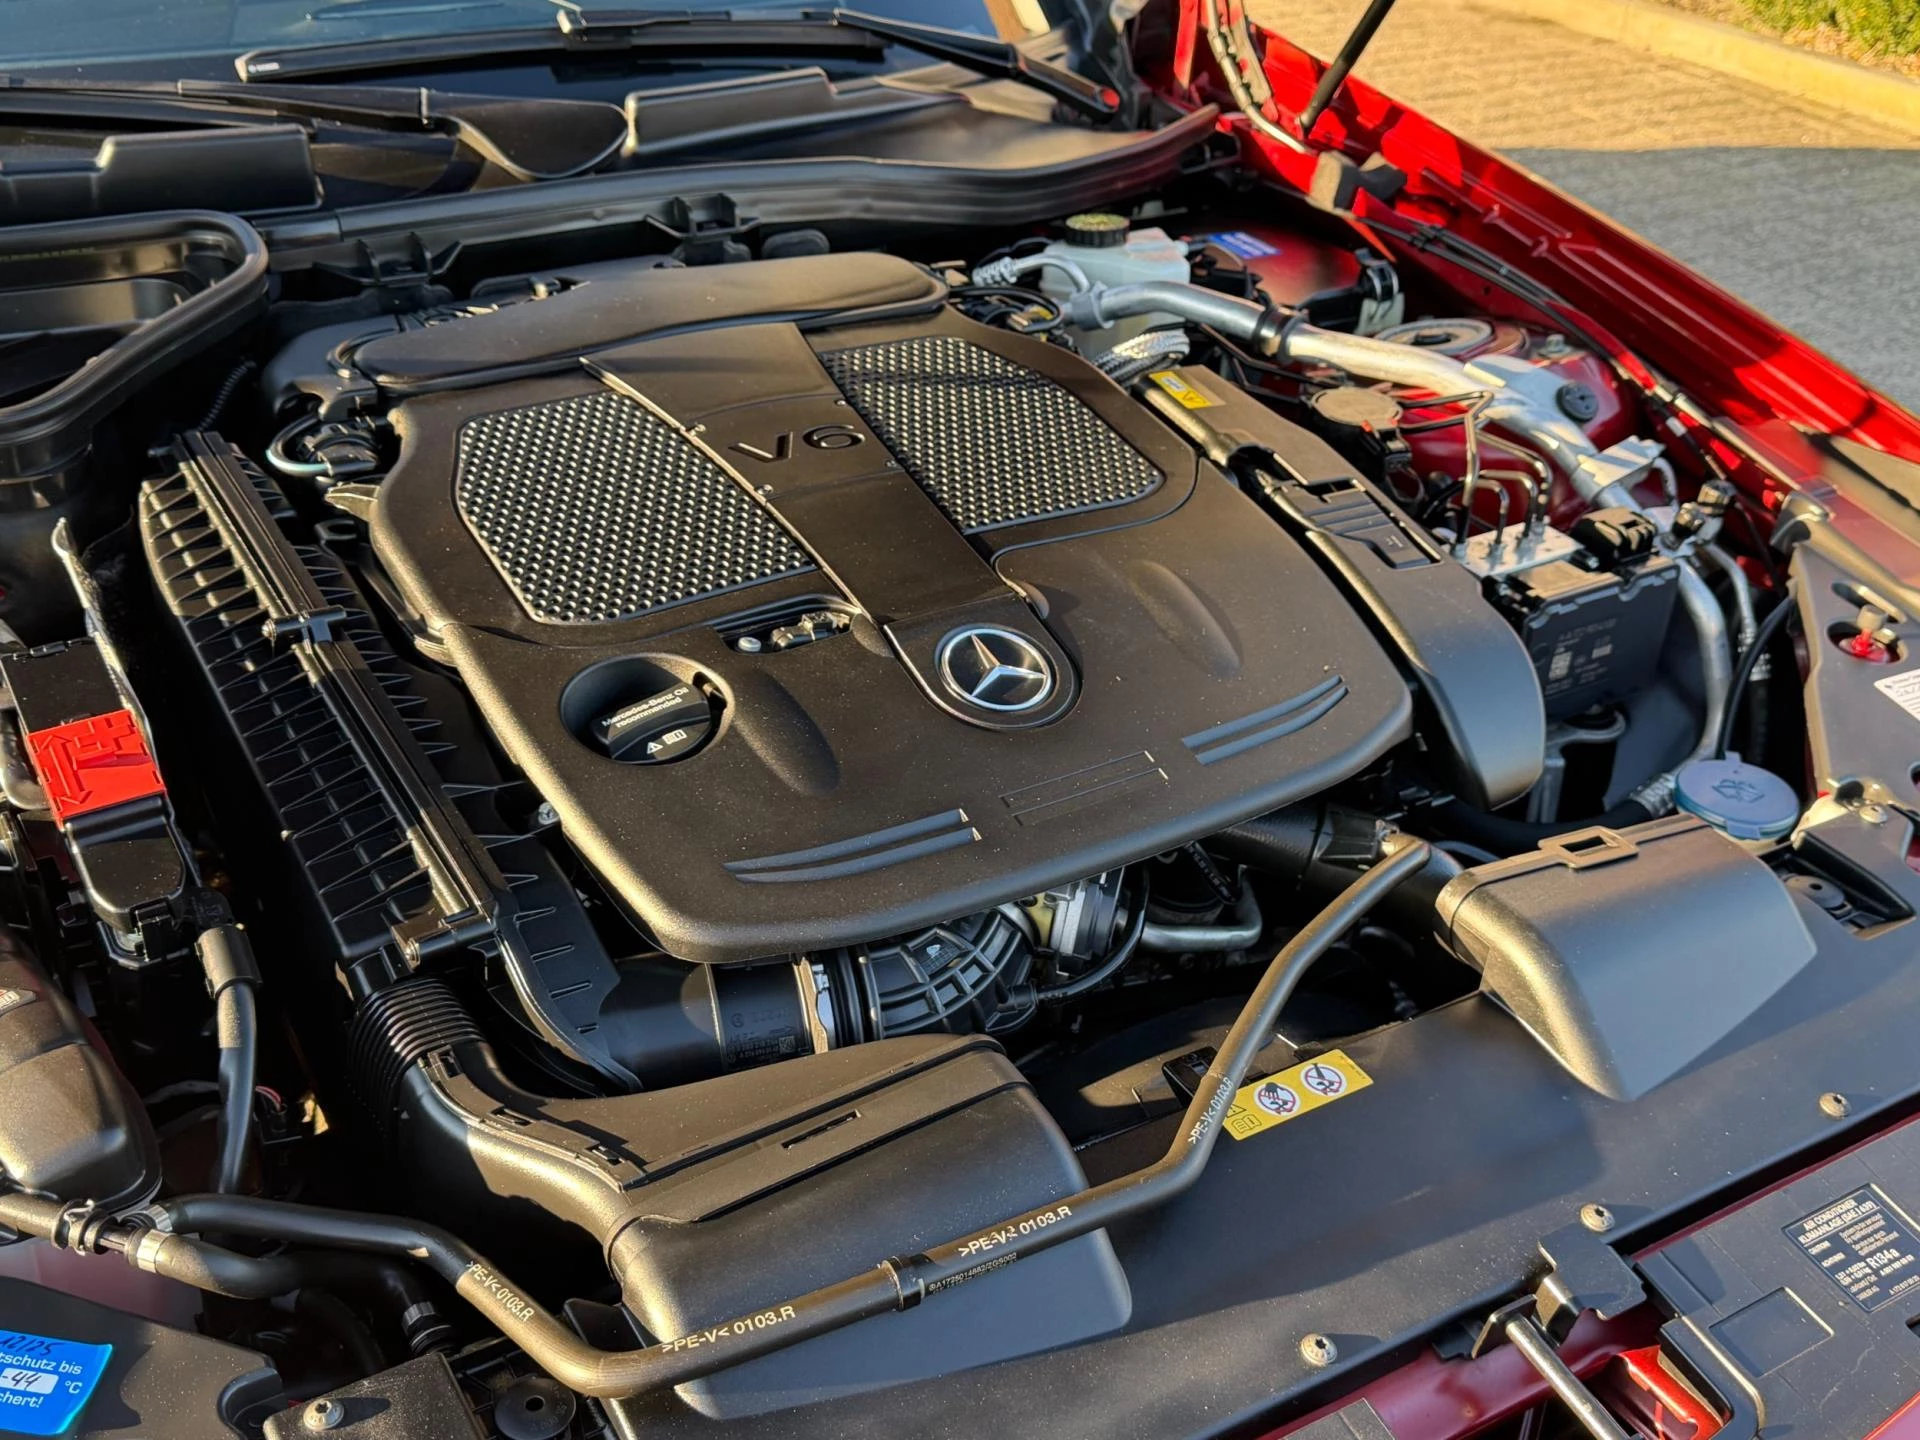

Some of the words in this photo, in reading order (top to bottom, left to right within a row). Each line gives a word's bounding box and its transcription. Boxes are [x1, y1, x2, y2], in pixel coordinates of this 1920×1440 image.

[728, 424, 865, 463] V6
[601, 693, 675, 726] Mercedes-Benz
[615, 696, 683, 728] recommended
[1019, 1205, 1072, 1235] 0103.R
[1866, 1248, 1900, 1269] R134a
[496, 1288, 534, 1322] 0103.R
[733, 1305, 796, 1334] 0103.R
[59, 1361, 82, 1375] bis
